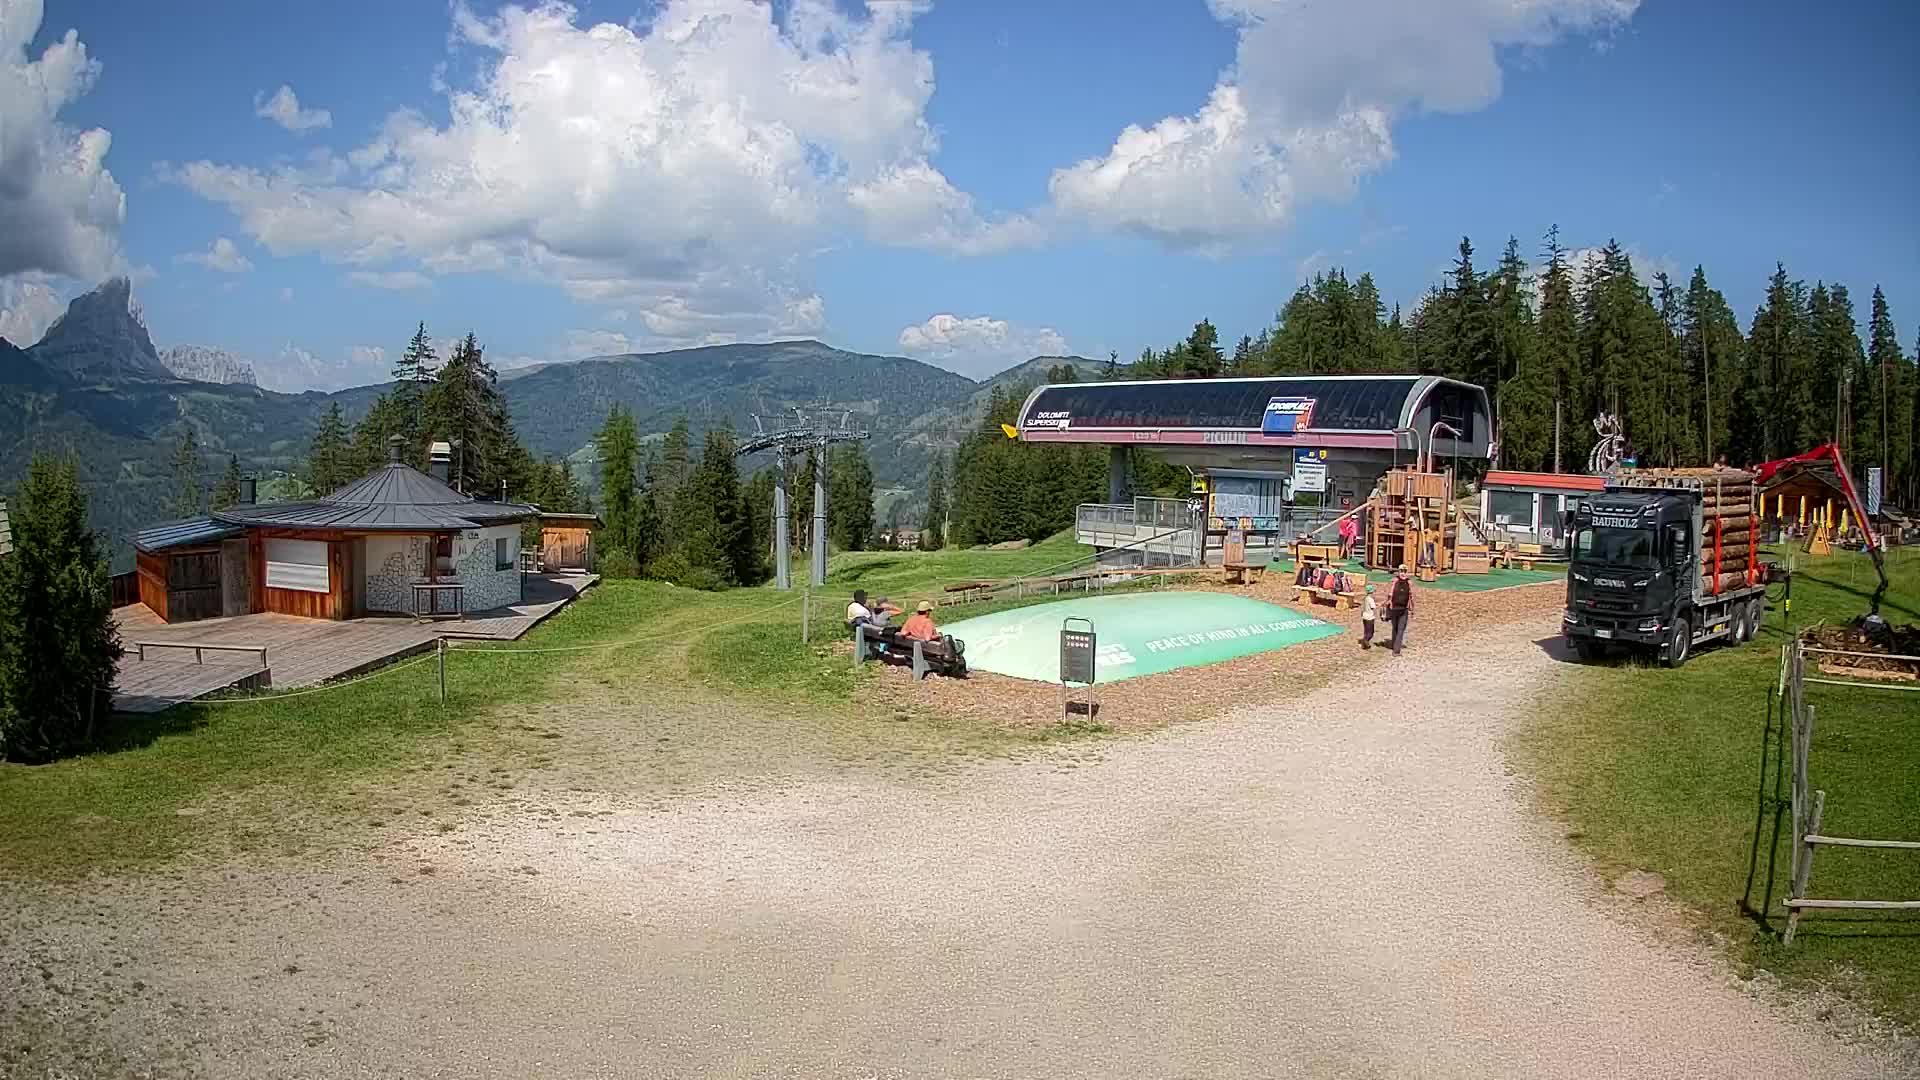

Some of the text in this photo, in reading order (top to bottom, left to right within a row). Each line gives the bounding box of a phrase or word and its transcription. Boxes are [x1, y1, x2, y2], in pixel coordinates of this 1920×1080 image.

[1037, 411, 1070, 419] DOLOMITI
[1026, 419, 1060, 427] SUPERSKI
[1591, 516, 1639, 529] BAUHOLZ
[1593, 578, 1626, 589] SCANIA
[1144, 636, 1190, 653] PEACE
[1189, 632, 1207, 647] OF
[1208, 629, 1236, 643] MIND
[1237, 626, 1251, 638] IN
[1250, 624, 1270, 636] ALL
